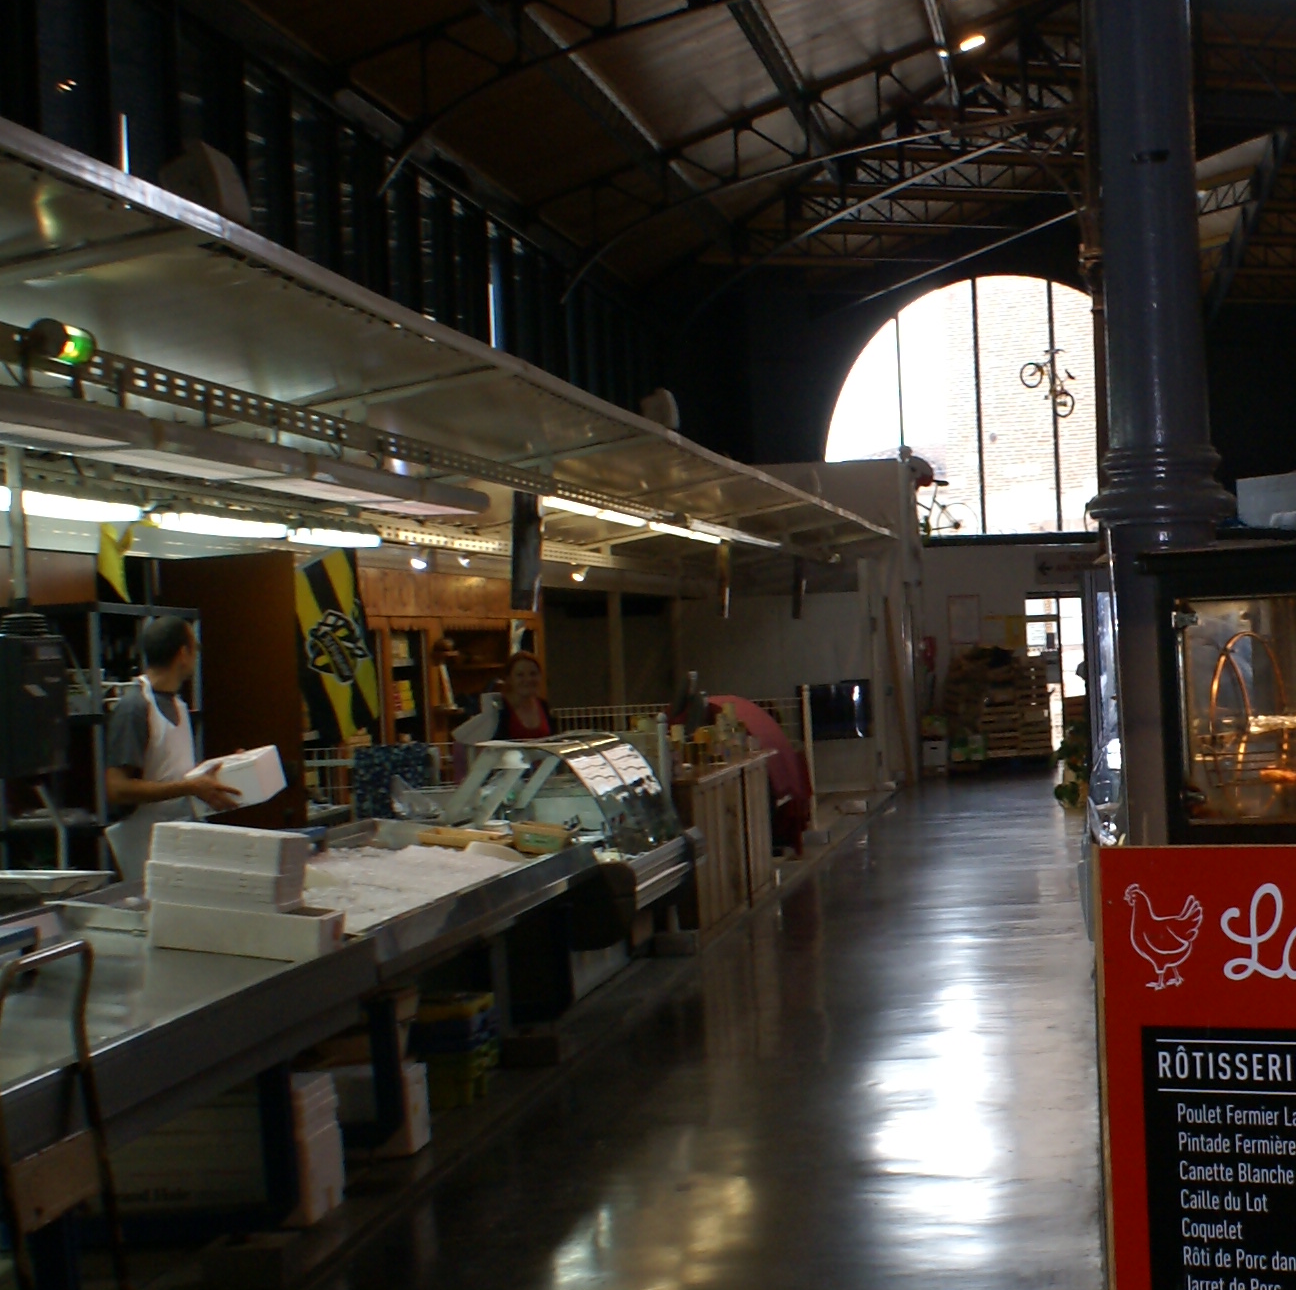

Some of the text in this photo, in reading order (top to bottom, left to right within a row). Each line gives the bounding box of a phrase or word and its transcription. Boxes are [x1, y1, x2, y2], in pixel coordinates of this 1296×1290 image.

[1177, 1102, 1222, 1124] Poulet
[1226, 1104, 1280, 1126] Fermier
[1178, 1131, 1296, 1156] Pintade Fermière
[1179, 1160, 1295, 1185] Canette Blanche
[1180, 1188, 1269, 1213] Caille du Lot
[1181, 1217, 1243, 1242] Coquelet
[1183, 1245, 1211, 1267] Rôti
[1214, 1248, 1232, 1268] de
[1235, 1248, 1267, 1270] Porc
